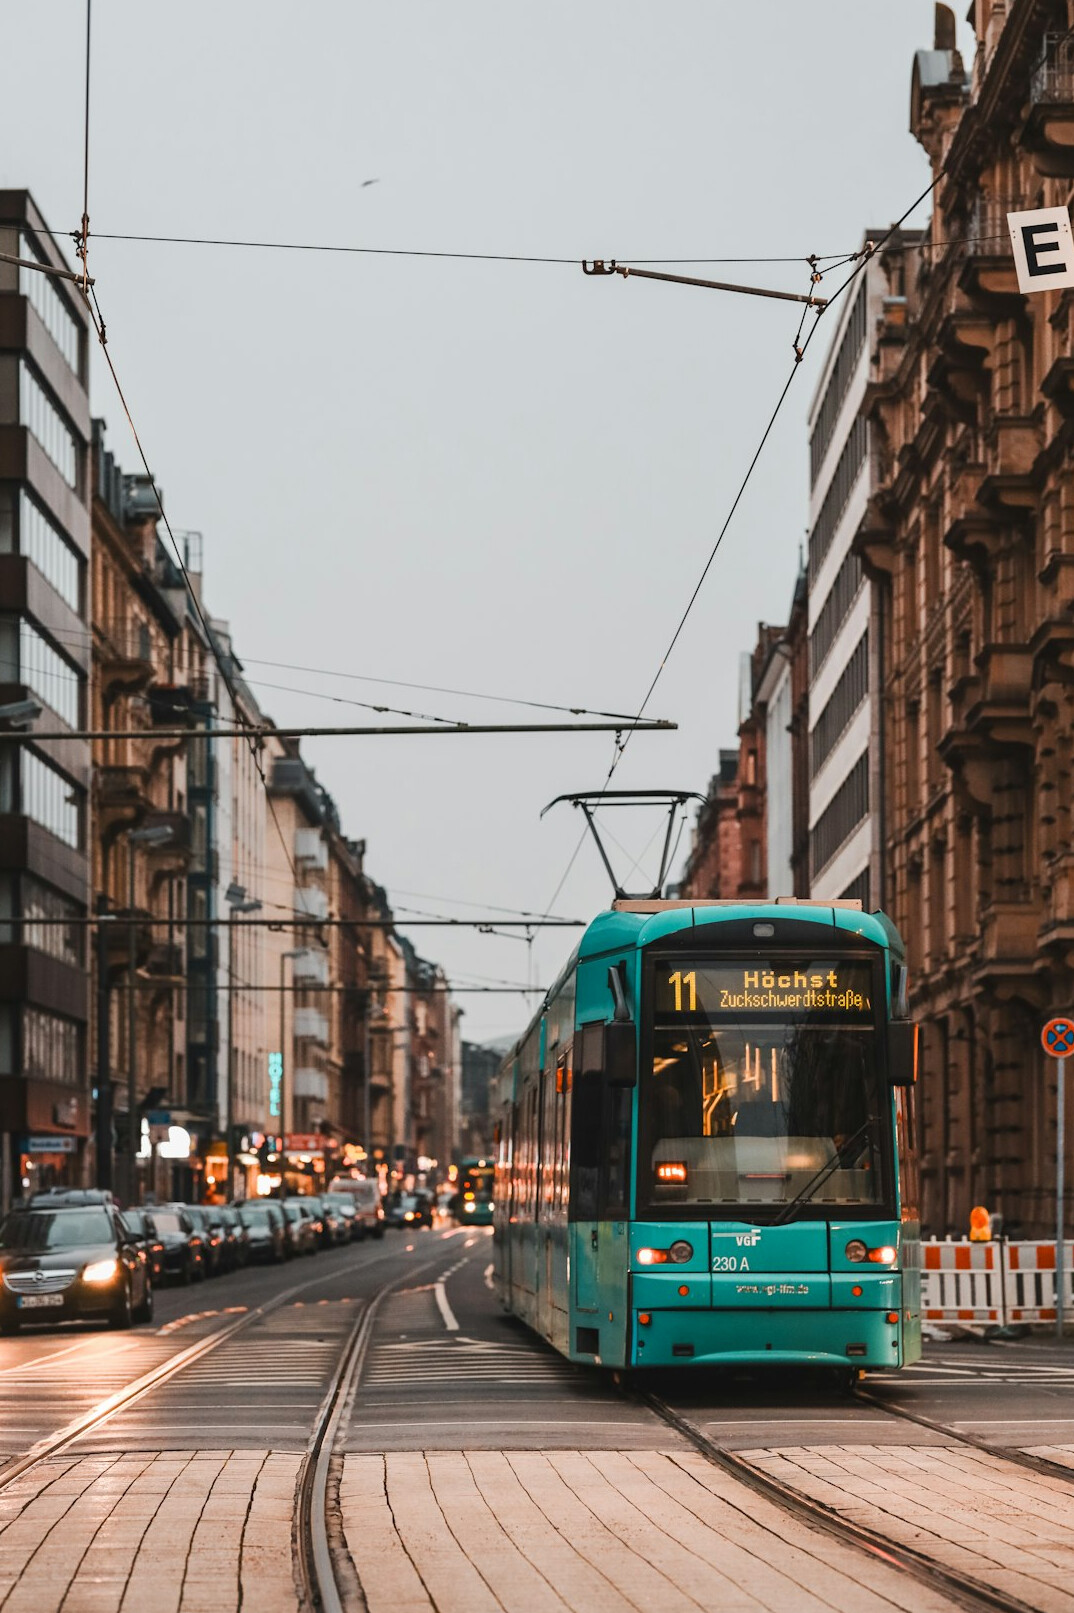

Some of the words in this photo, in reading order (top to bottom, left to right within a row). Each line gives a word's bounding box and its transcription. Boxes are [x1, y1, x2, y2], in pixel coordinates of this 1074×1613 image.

[1021, 222, 1067, 277] E
[744, 970, 838, 989] Höchst
[668, 971, 697, 1011] 11
[720, 990, 863, 1011] Zuckschwerdtstraße
[268, 1052, 283, 1117] HOTEL
[736, 1229, 761, 1246] VGF
[712, 1256, 737, 1271] 230
[739, 1256, 750, 1271] A
